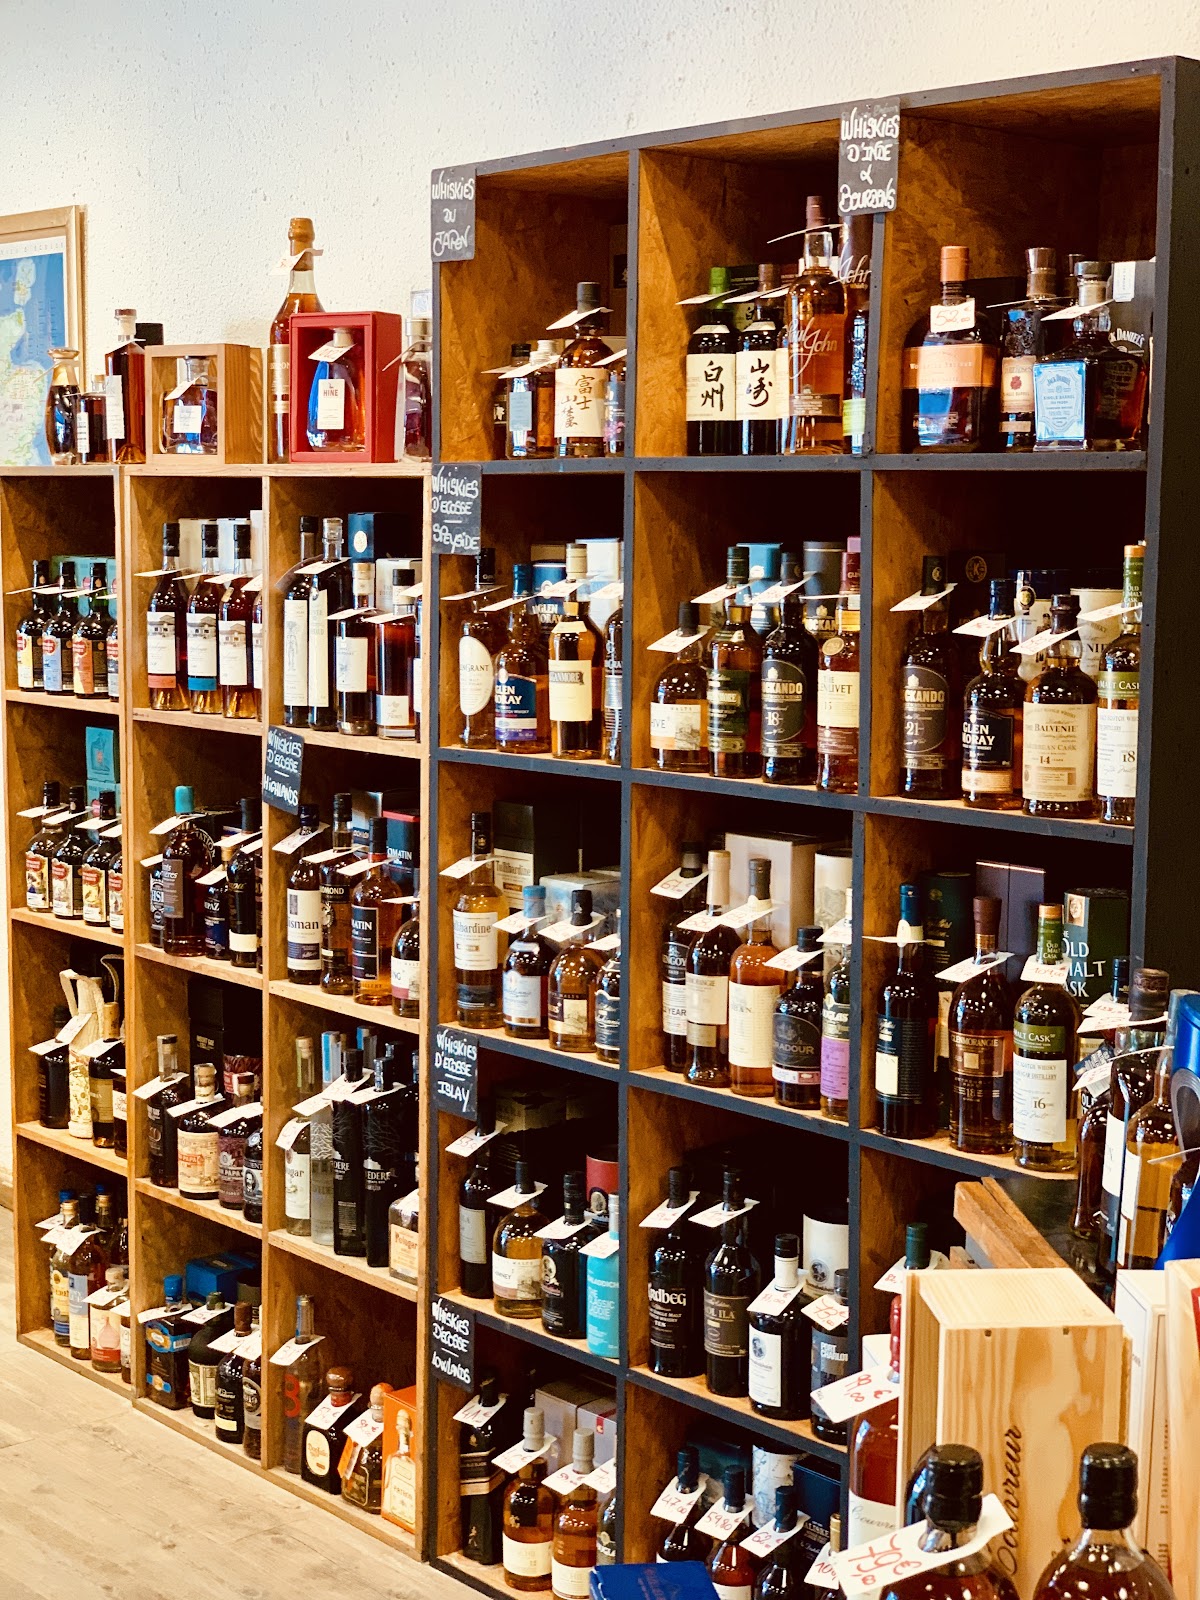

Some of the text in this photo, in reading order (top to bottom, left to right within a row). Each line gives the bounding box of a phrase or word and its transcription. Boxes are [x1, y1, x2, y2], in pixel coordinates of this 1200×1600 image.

[700, 361, 725, 412] 白州
[747, 358, 773, 408] 山崎
[575, 374, 596, 411] 富士
[767, 711, 780, 725] 18
[906, 722, 919, 735] 21
[962, 722, 990, 735] GLEN
[1034, 723, 1077, 732] BALVENIE
[1039, 755, 1050, 764] 14
[1122, 750, 1135, 762] 18
[667, 1008, 686, 1016] YEAR
[1028, 1033, 1051, 1042] CASK
[437, 1081, 470, 1113] ISLAY
[1033, 1098, 1047, 1110] 16
[820, 1342, 837, 1354] PORT
[705, 1511, 733, 1531] 59,80
